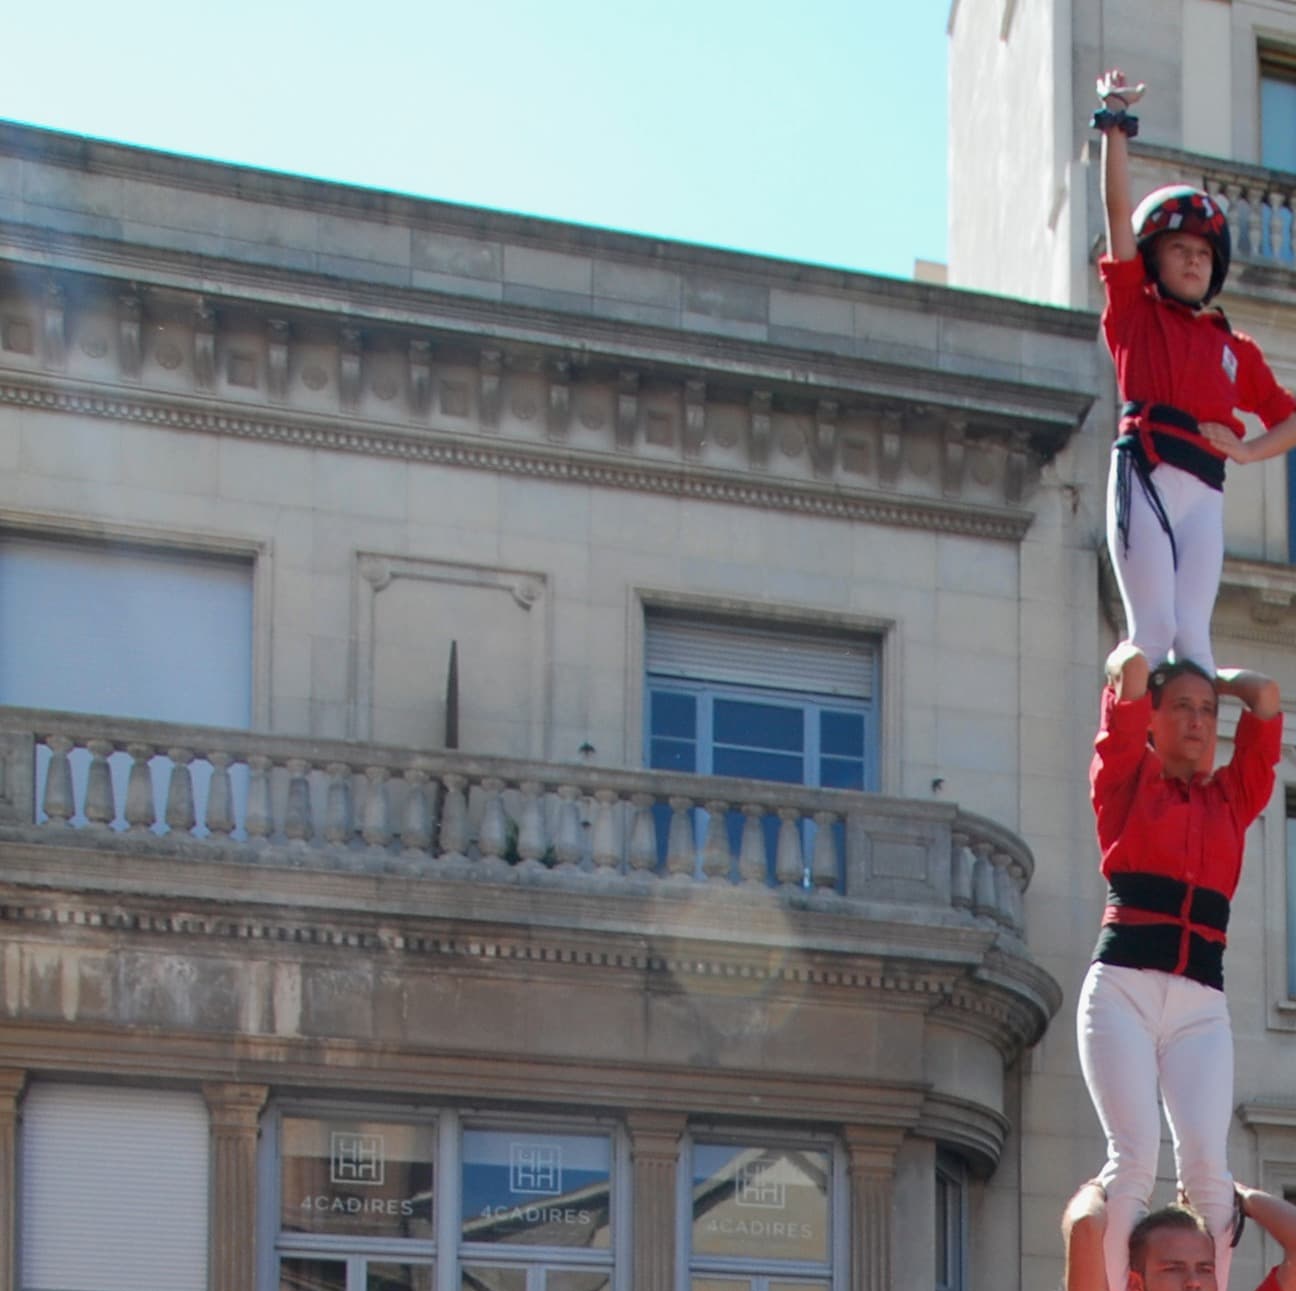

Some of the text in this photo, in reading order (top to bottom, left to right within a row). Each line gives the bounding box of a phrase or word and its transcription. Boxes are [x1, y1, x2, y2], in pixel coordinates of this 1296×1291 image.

[300, 1195, 415, 1216] 4CADIRES
[481, 1204, 592, 1225] 4CADIRES
[705, 1219, 813, 1239] 4CADIRES
